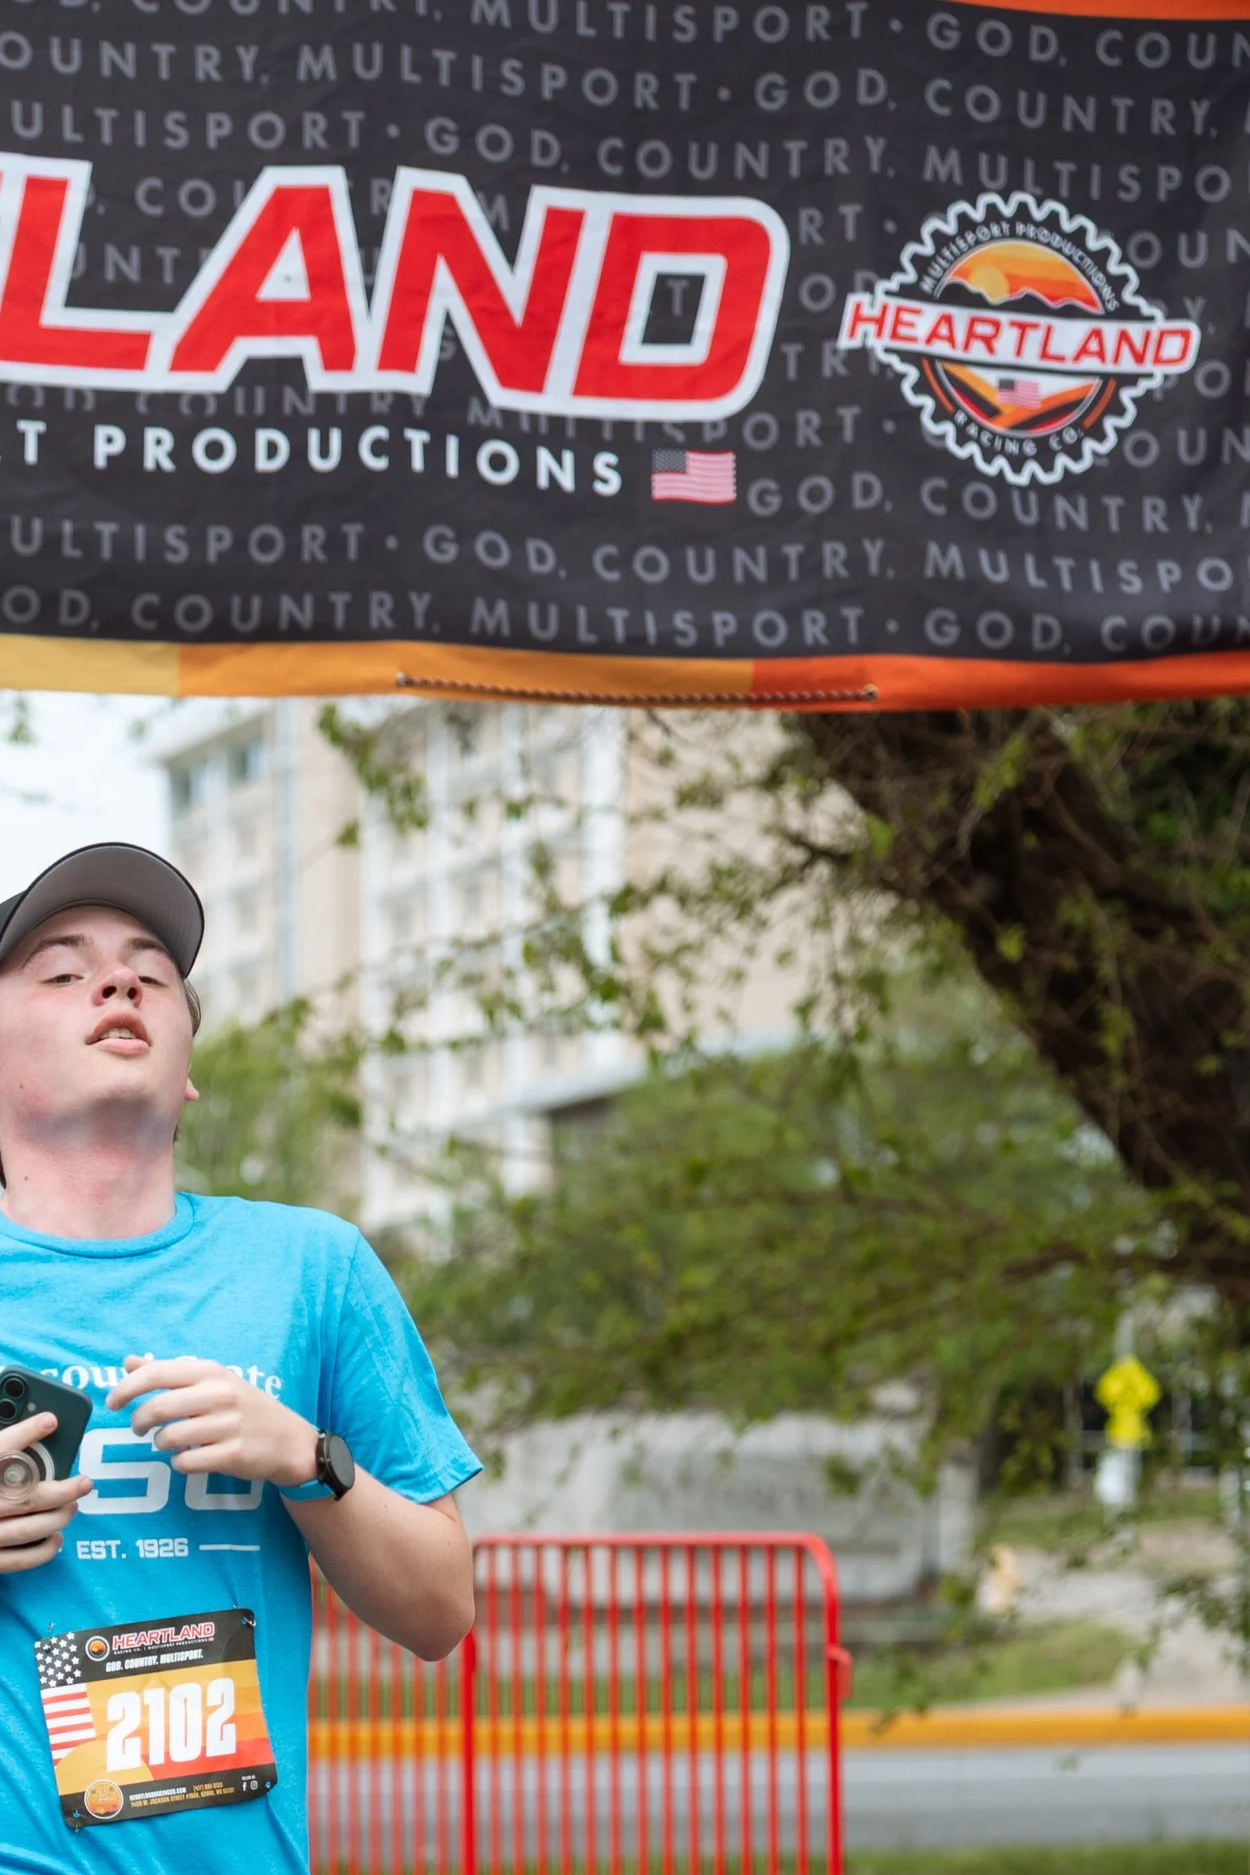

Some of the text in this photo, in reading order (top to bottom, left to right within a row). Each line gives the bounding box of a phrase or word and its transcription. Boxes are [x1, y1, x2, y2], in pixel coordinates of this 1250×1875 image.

[470, 0, 870, 44] MULTISPORT
[297, 41, 698, 109] MULTISPORT
[919, 221, 1010, 295] MULTISPORT
[1015, 221, 1120, 312] PRODUCTIONS
[846, 299, 1194, 368] HEARTLAND
[92, 425, 624, 498] PRODUCTIONS
[953, 410, 1038, 457] RACING
[470, 596, 864, 651] MULTISPORT
[76, 1537, 189, 1560] EST. 1926
[112, 1622, 215, 1650] HEARTLAND
[106, 1677, 237, 1773] 2102
